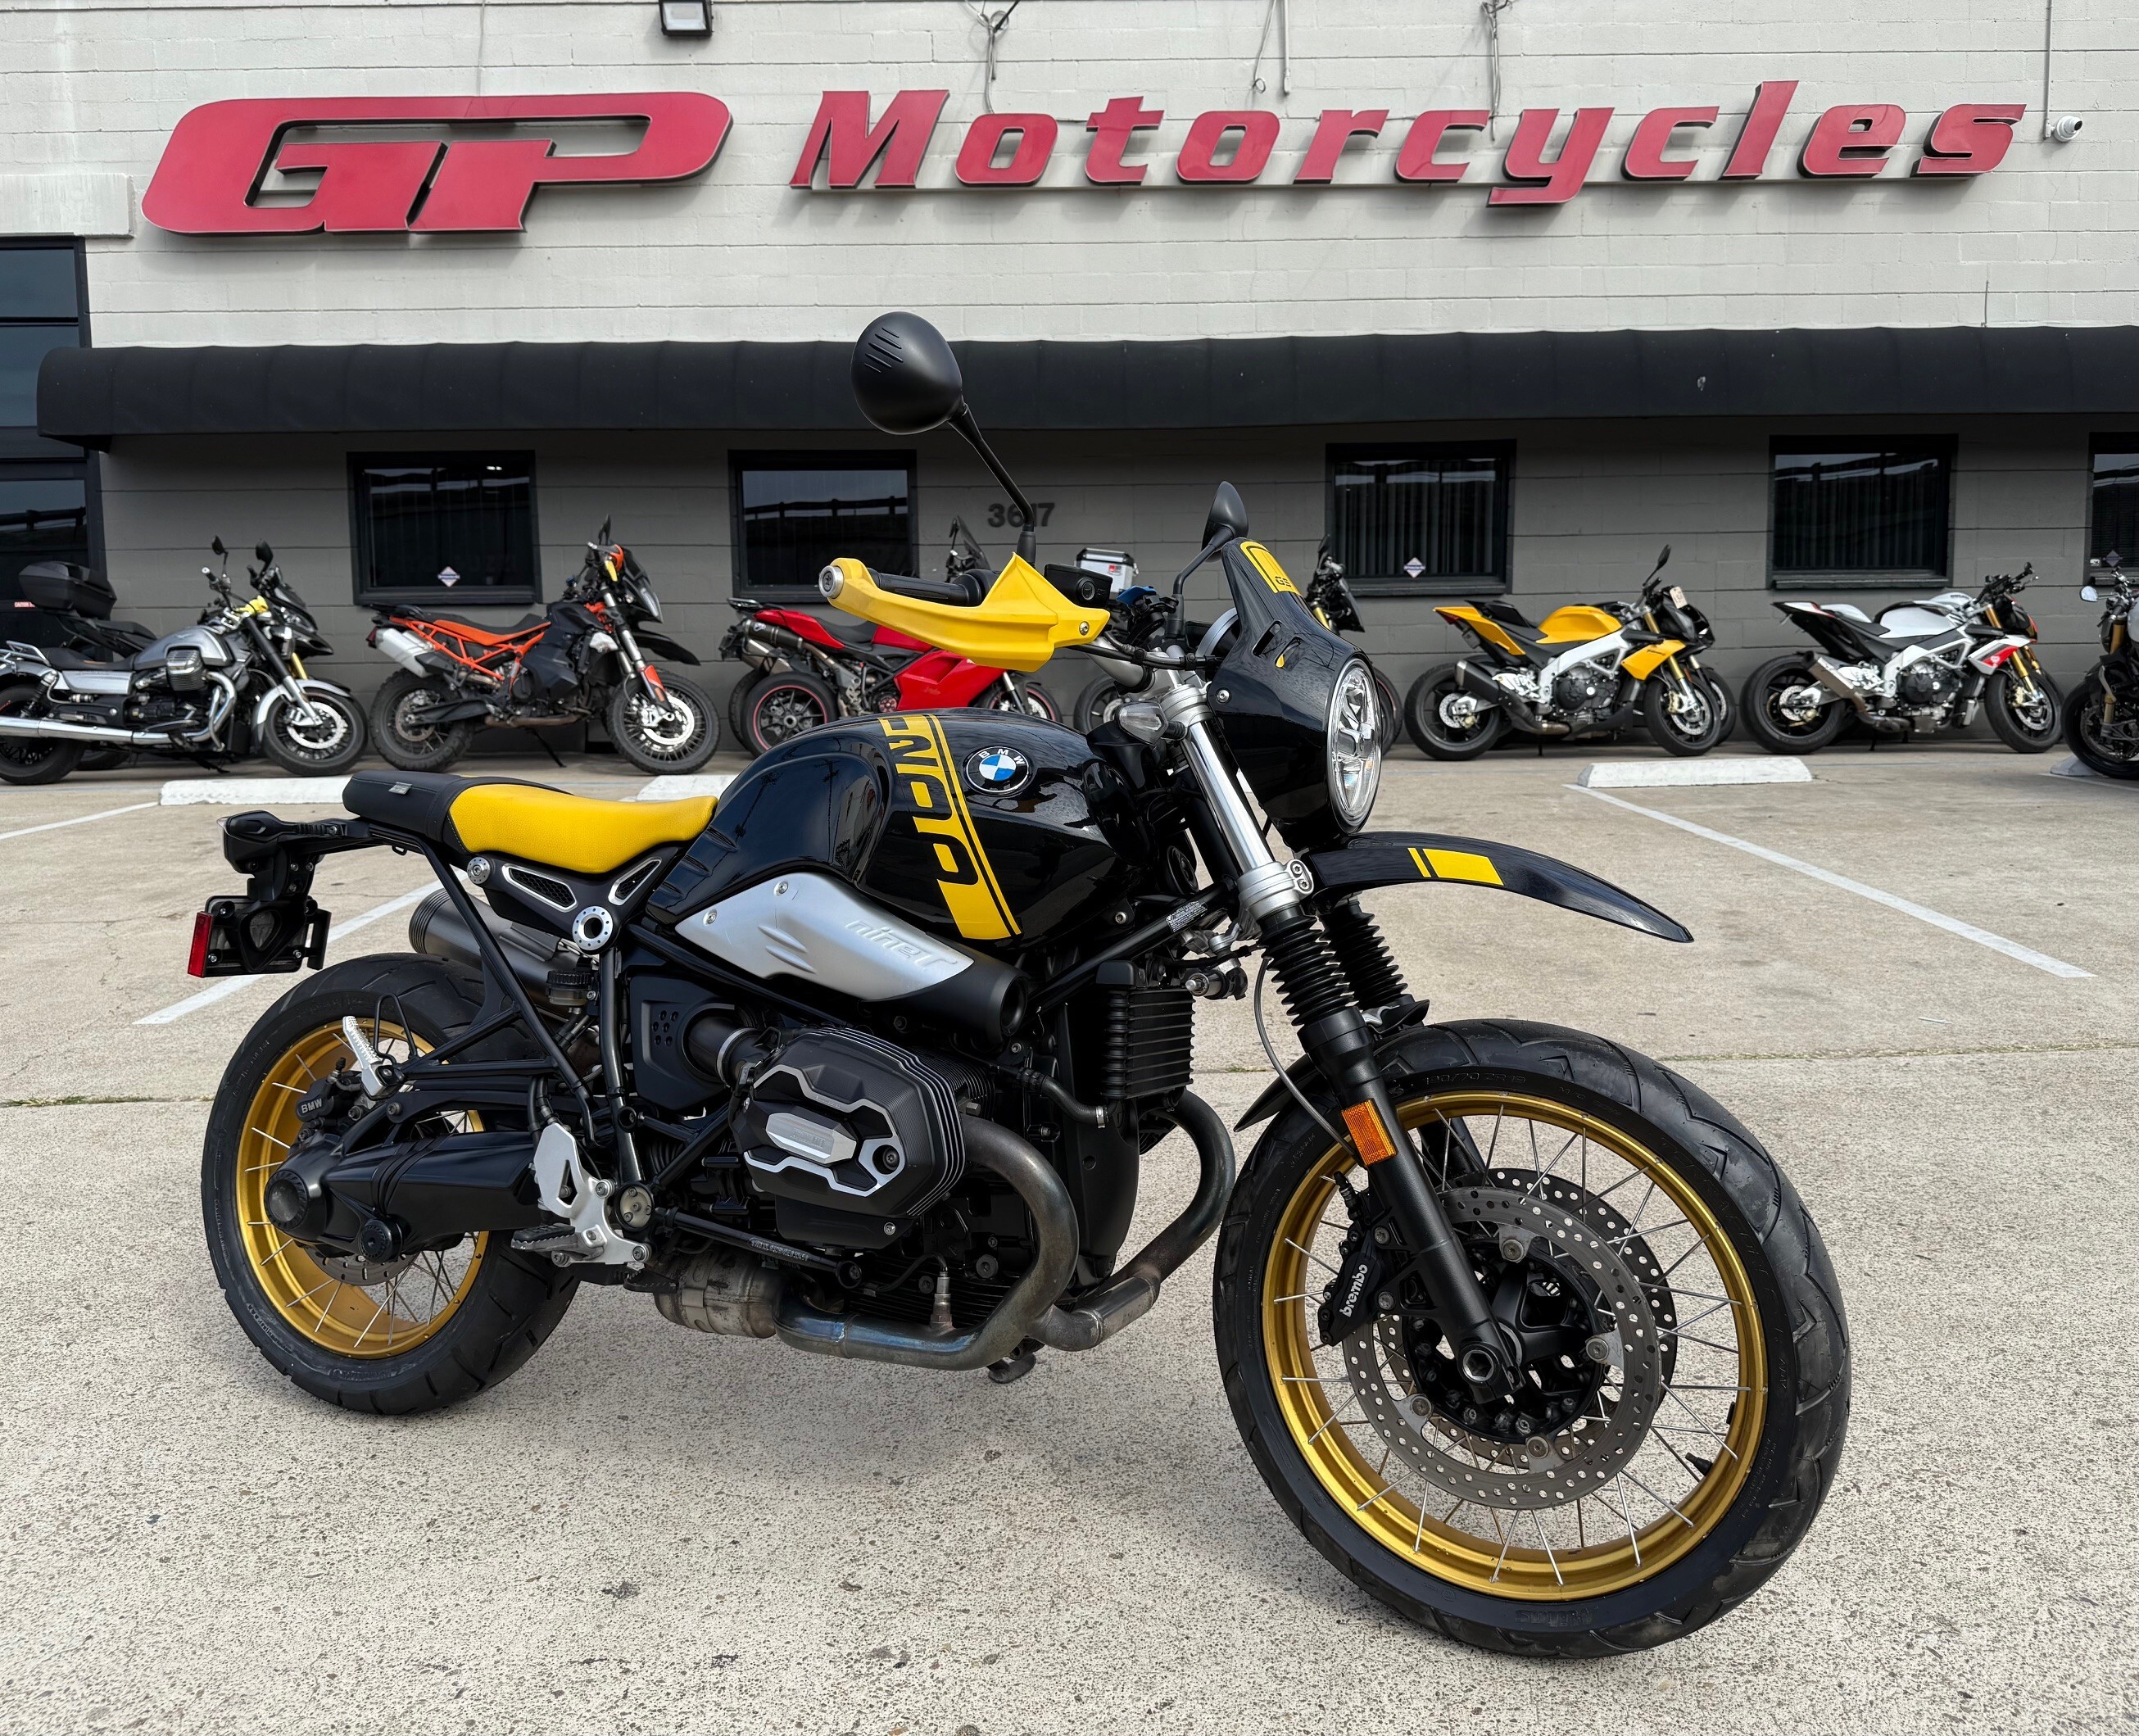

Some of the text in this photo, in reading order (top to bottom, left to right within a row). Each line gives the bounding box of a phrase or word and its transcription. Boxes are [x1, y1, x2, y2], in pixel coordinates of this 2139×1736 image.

[142, 79, 2028, 234] GP Motorcycles
[1274, 575, 1292, 587] GS
[978, 747, 1026, 766] BMW
[301, 1098, 322, 1114] BMW
[1339, 1264, 1368, 1317] brembo
